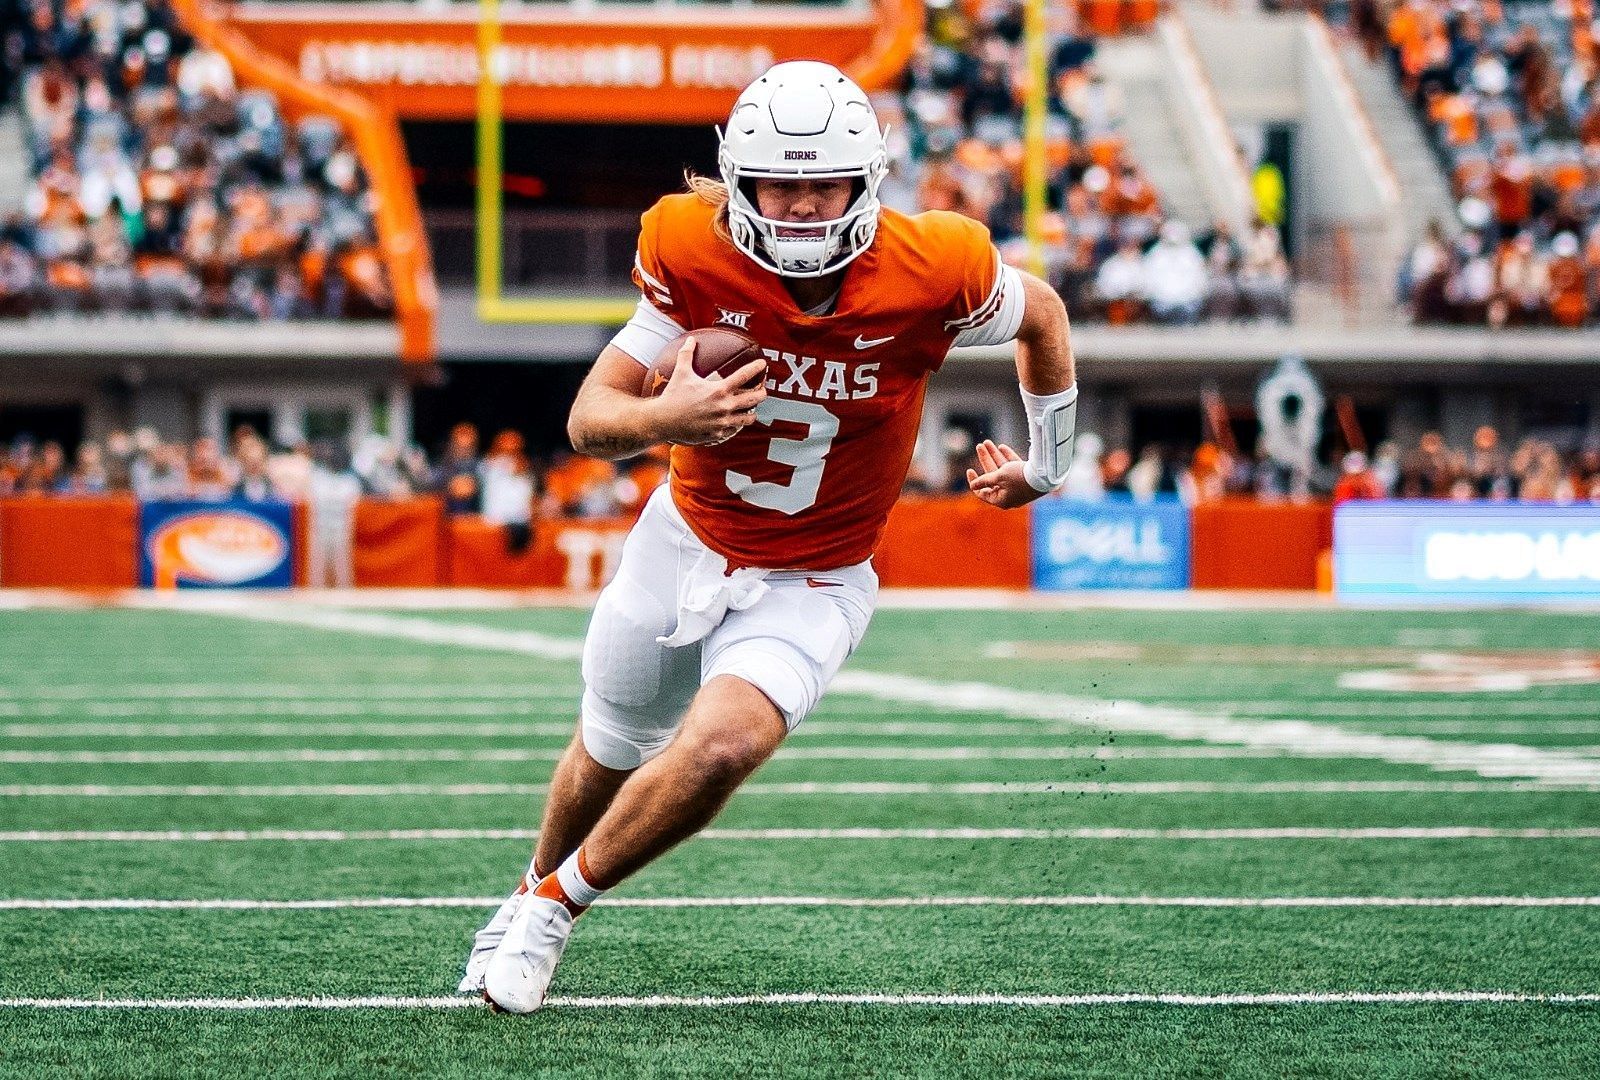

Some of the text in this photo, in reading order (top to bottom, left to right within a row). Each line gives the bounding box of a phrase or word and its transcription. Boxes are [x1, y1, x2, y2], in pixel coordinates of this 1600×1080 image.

[784, 150, 817, 160] HORNS
[716, 307, 751, 331] XII
[725, 396, 840, 515] 3
